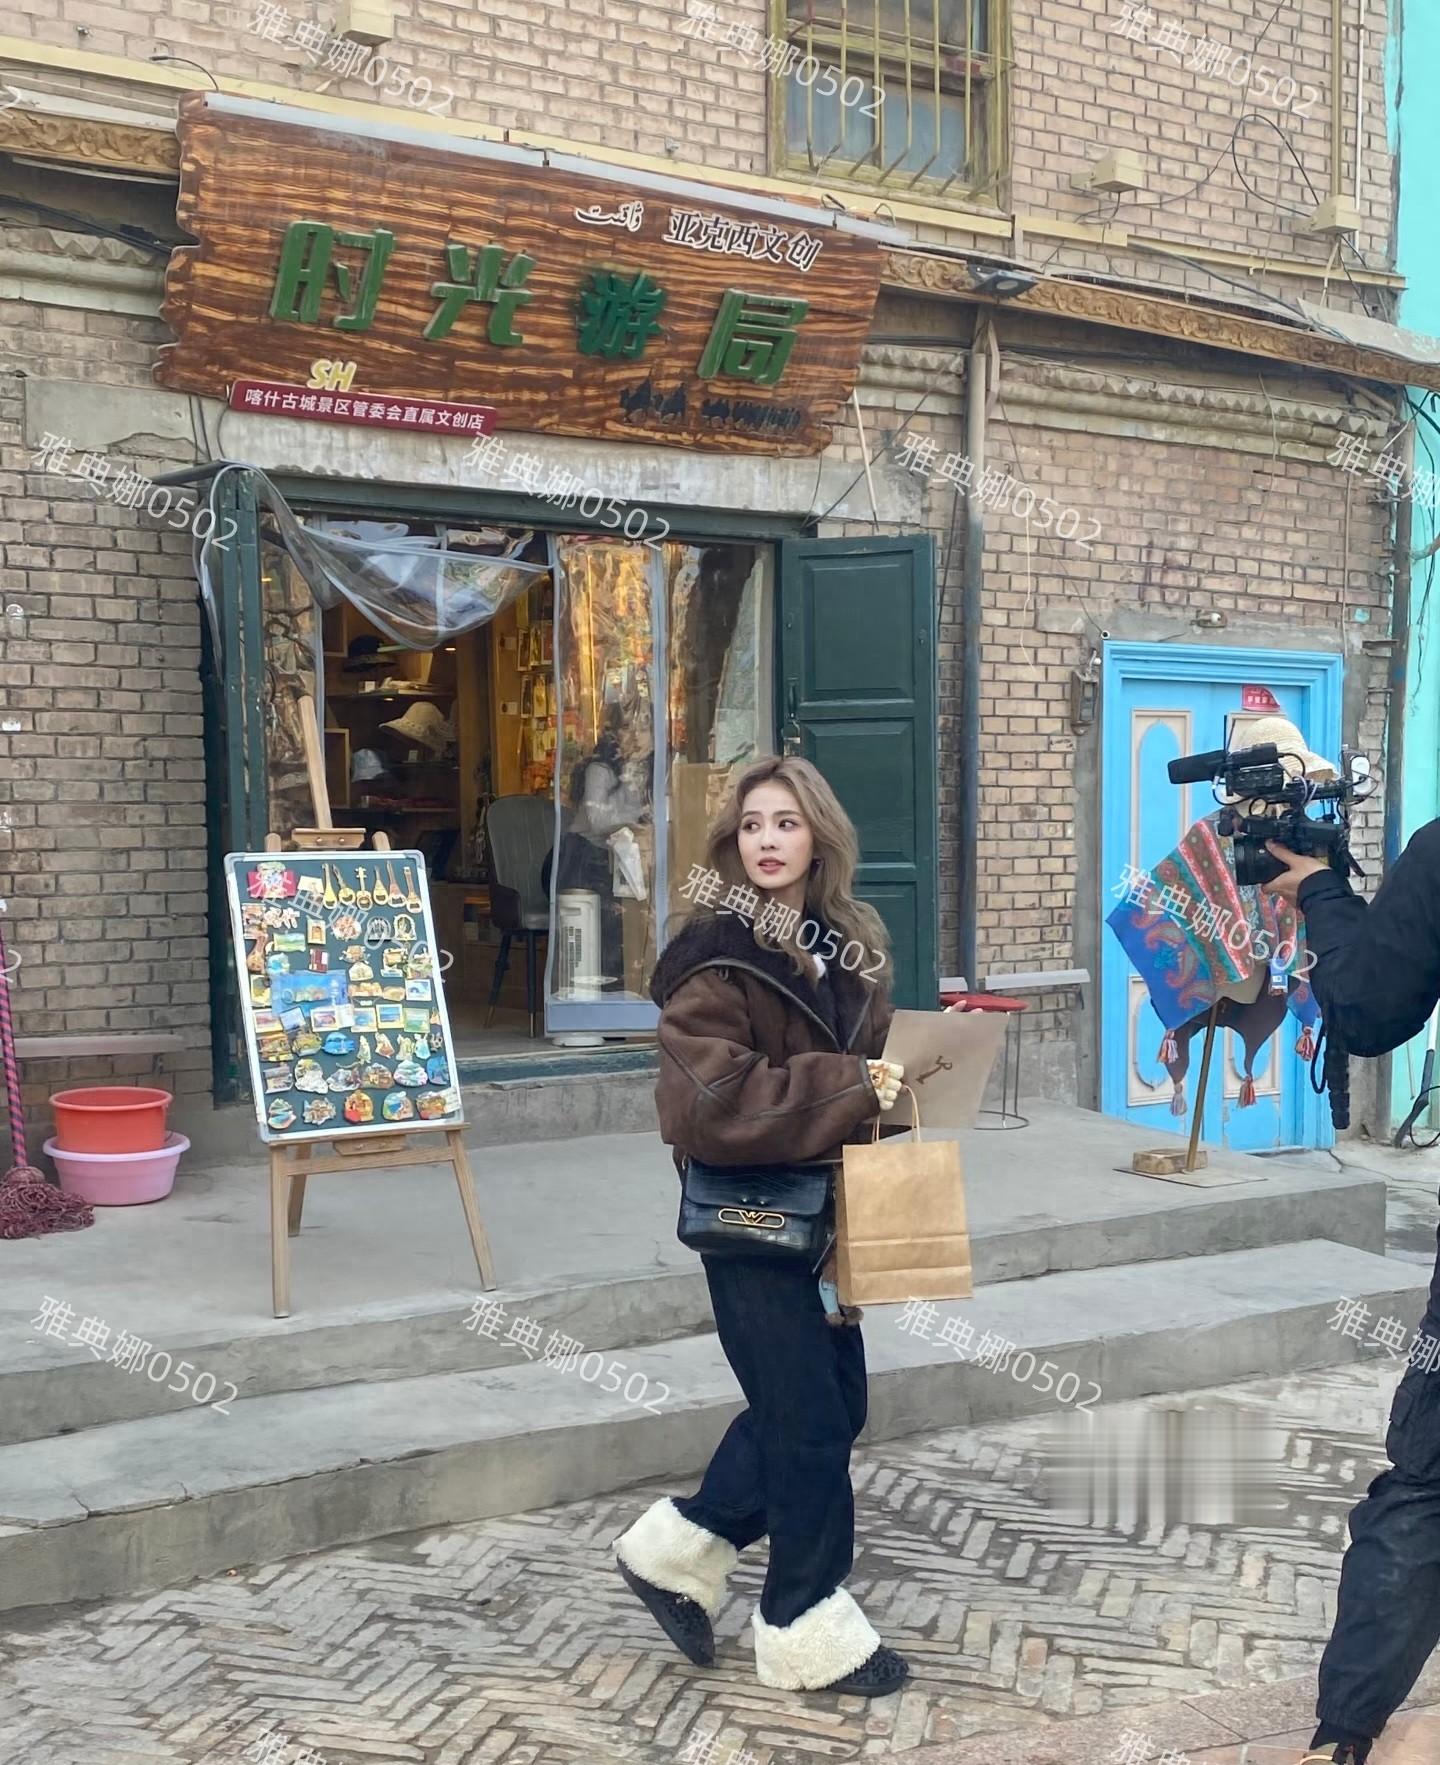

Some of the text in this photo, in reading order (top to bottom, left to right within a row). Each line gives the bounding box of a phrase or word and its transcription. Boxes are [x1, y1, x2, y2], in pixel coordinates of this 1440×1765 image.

[663, 207, 823, 271] 亚克西文创
[307, 358, 357, 392] SH
[244, 388, 486, 430] 喀什古城景区管委会直属文创店
